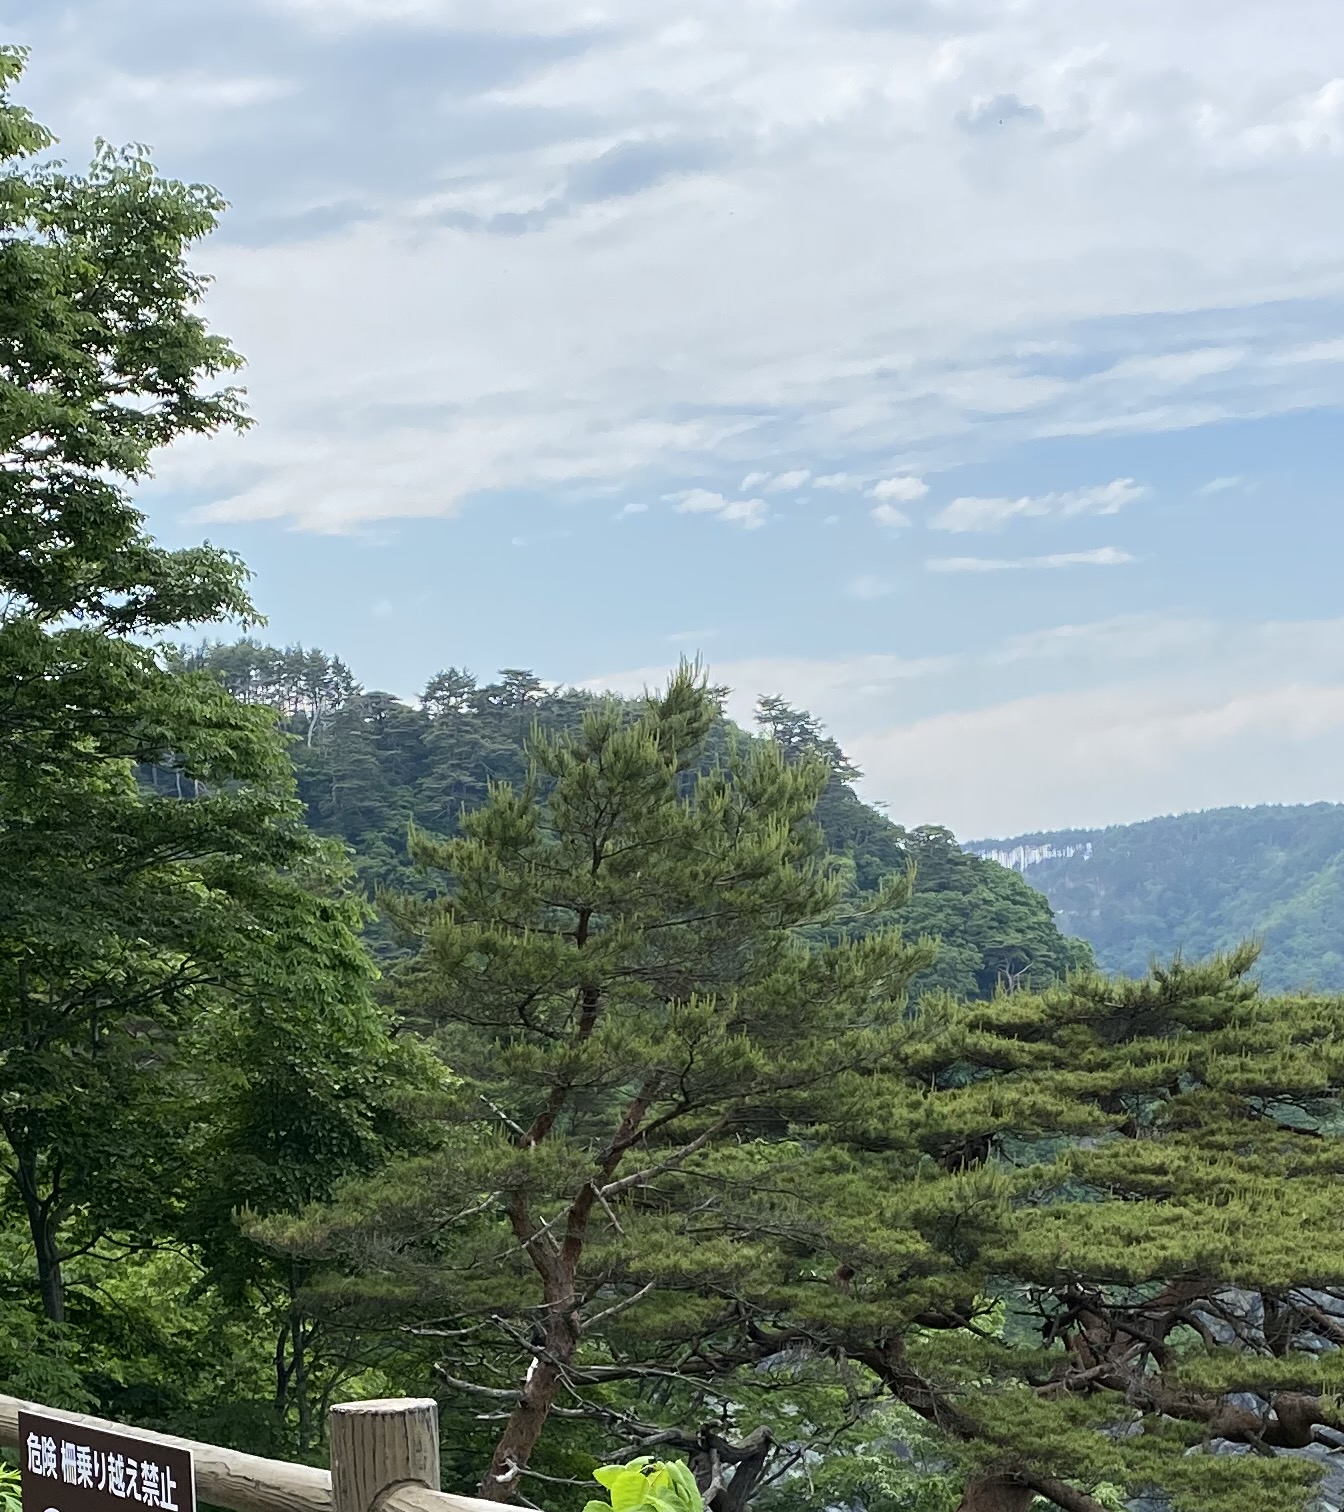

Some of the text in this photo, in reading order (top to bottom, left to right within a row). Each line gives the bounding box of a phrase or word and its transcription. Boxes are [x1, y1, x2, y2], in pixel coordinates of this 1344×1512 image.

[26, 1431, 179, 1512] 危険 柵乗り越え禁止
